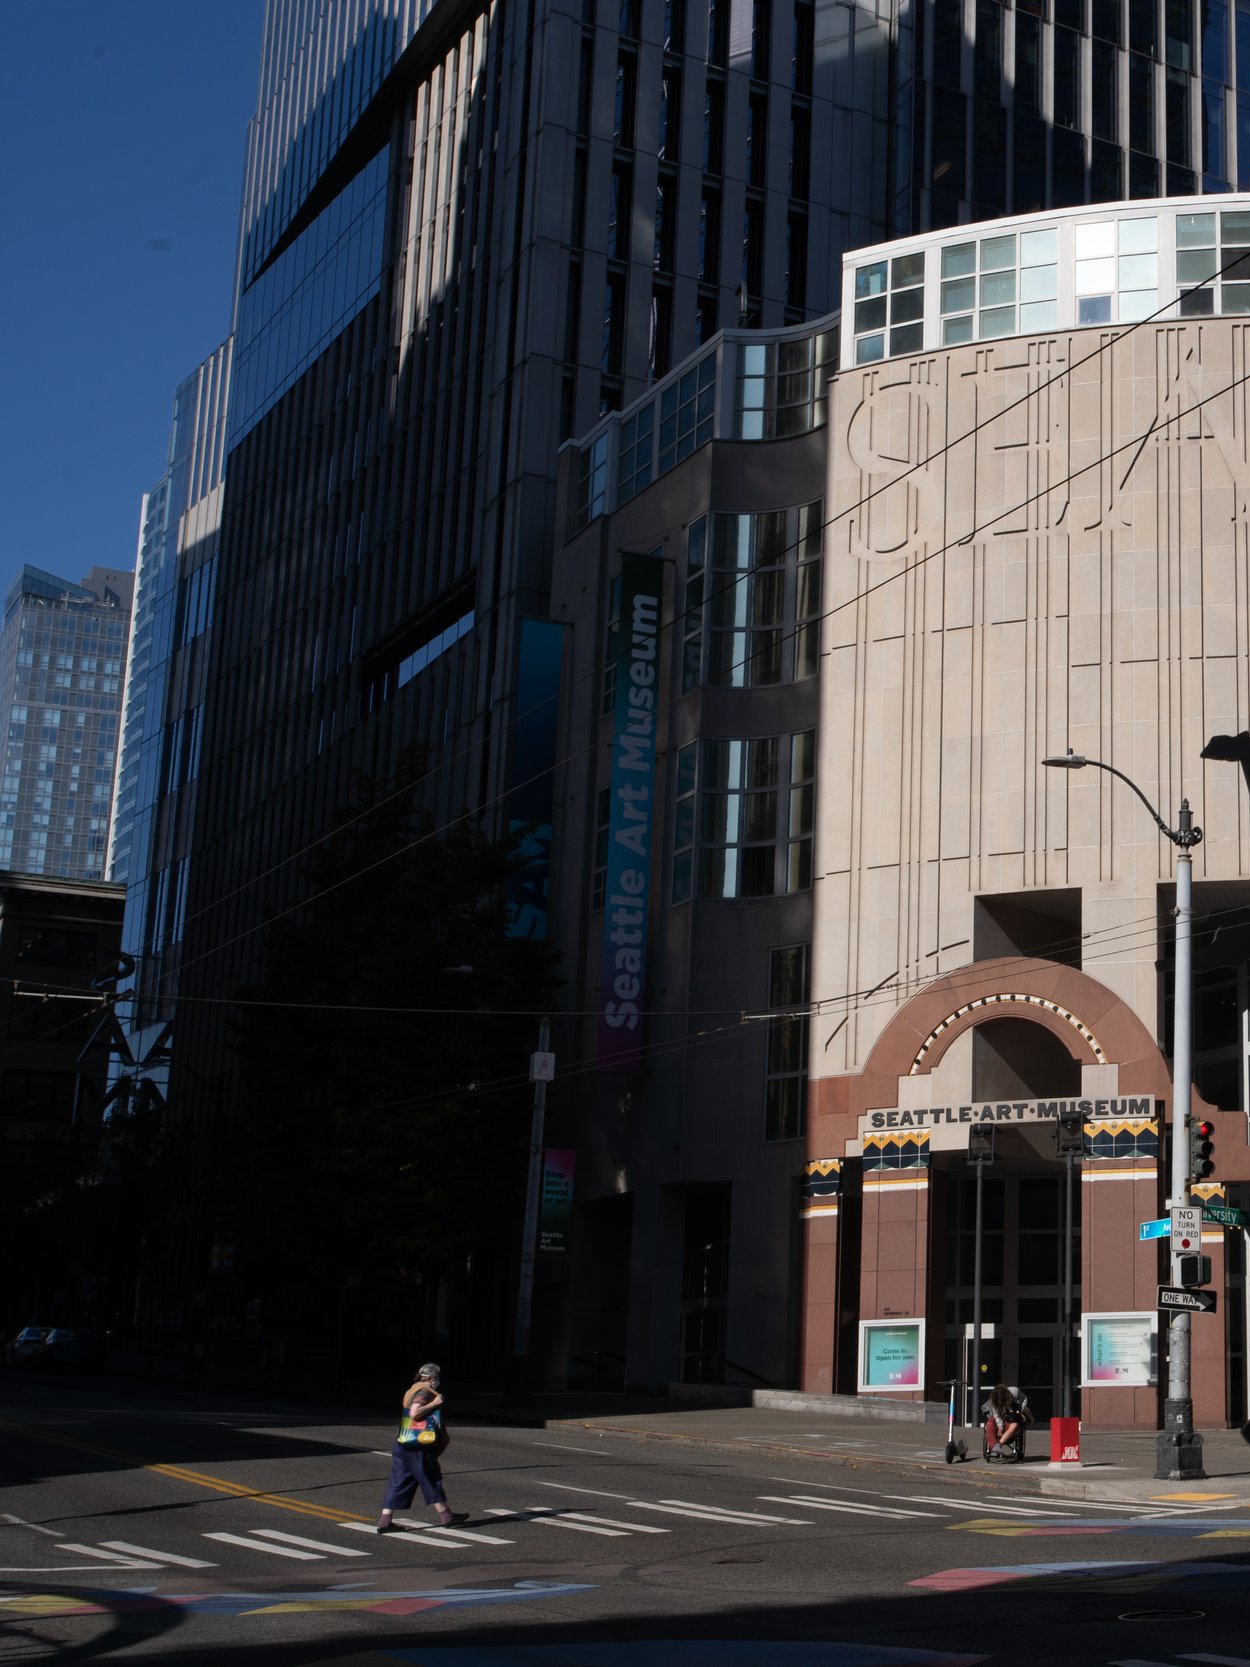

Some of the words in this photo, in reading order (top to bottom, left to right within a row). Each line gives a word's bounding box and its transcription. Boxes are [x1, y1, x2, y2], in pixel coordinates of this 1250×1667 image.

[619, 592, 660, 774] Museum
[614, 784, 650, 856] Art
[605, 868, 646, 1032] Seattle
[871, 1106, 973, 1128] SEATTLE
[979, 1103, 1027, 1121] ART
[1037, 1098, 1151, 1118] MUSEUM
[544, 1188, 568, 1196] world
[1179, 1211, 1193, 1220] NO
[1164, 1293, 1180, 1304] ONE
[1182, 1295, 1198, 1305] WAY
